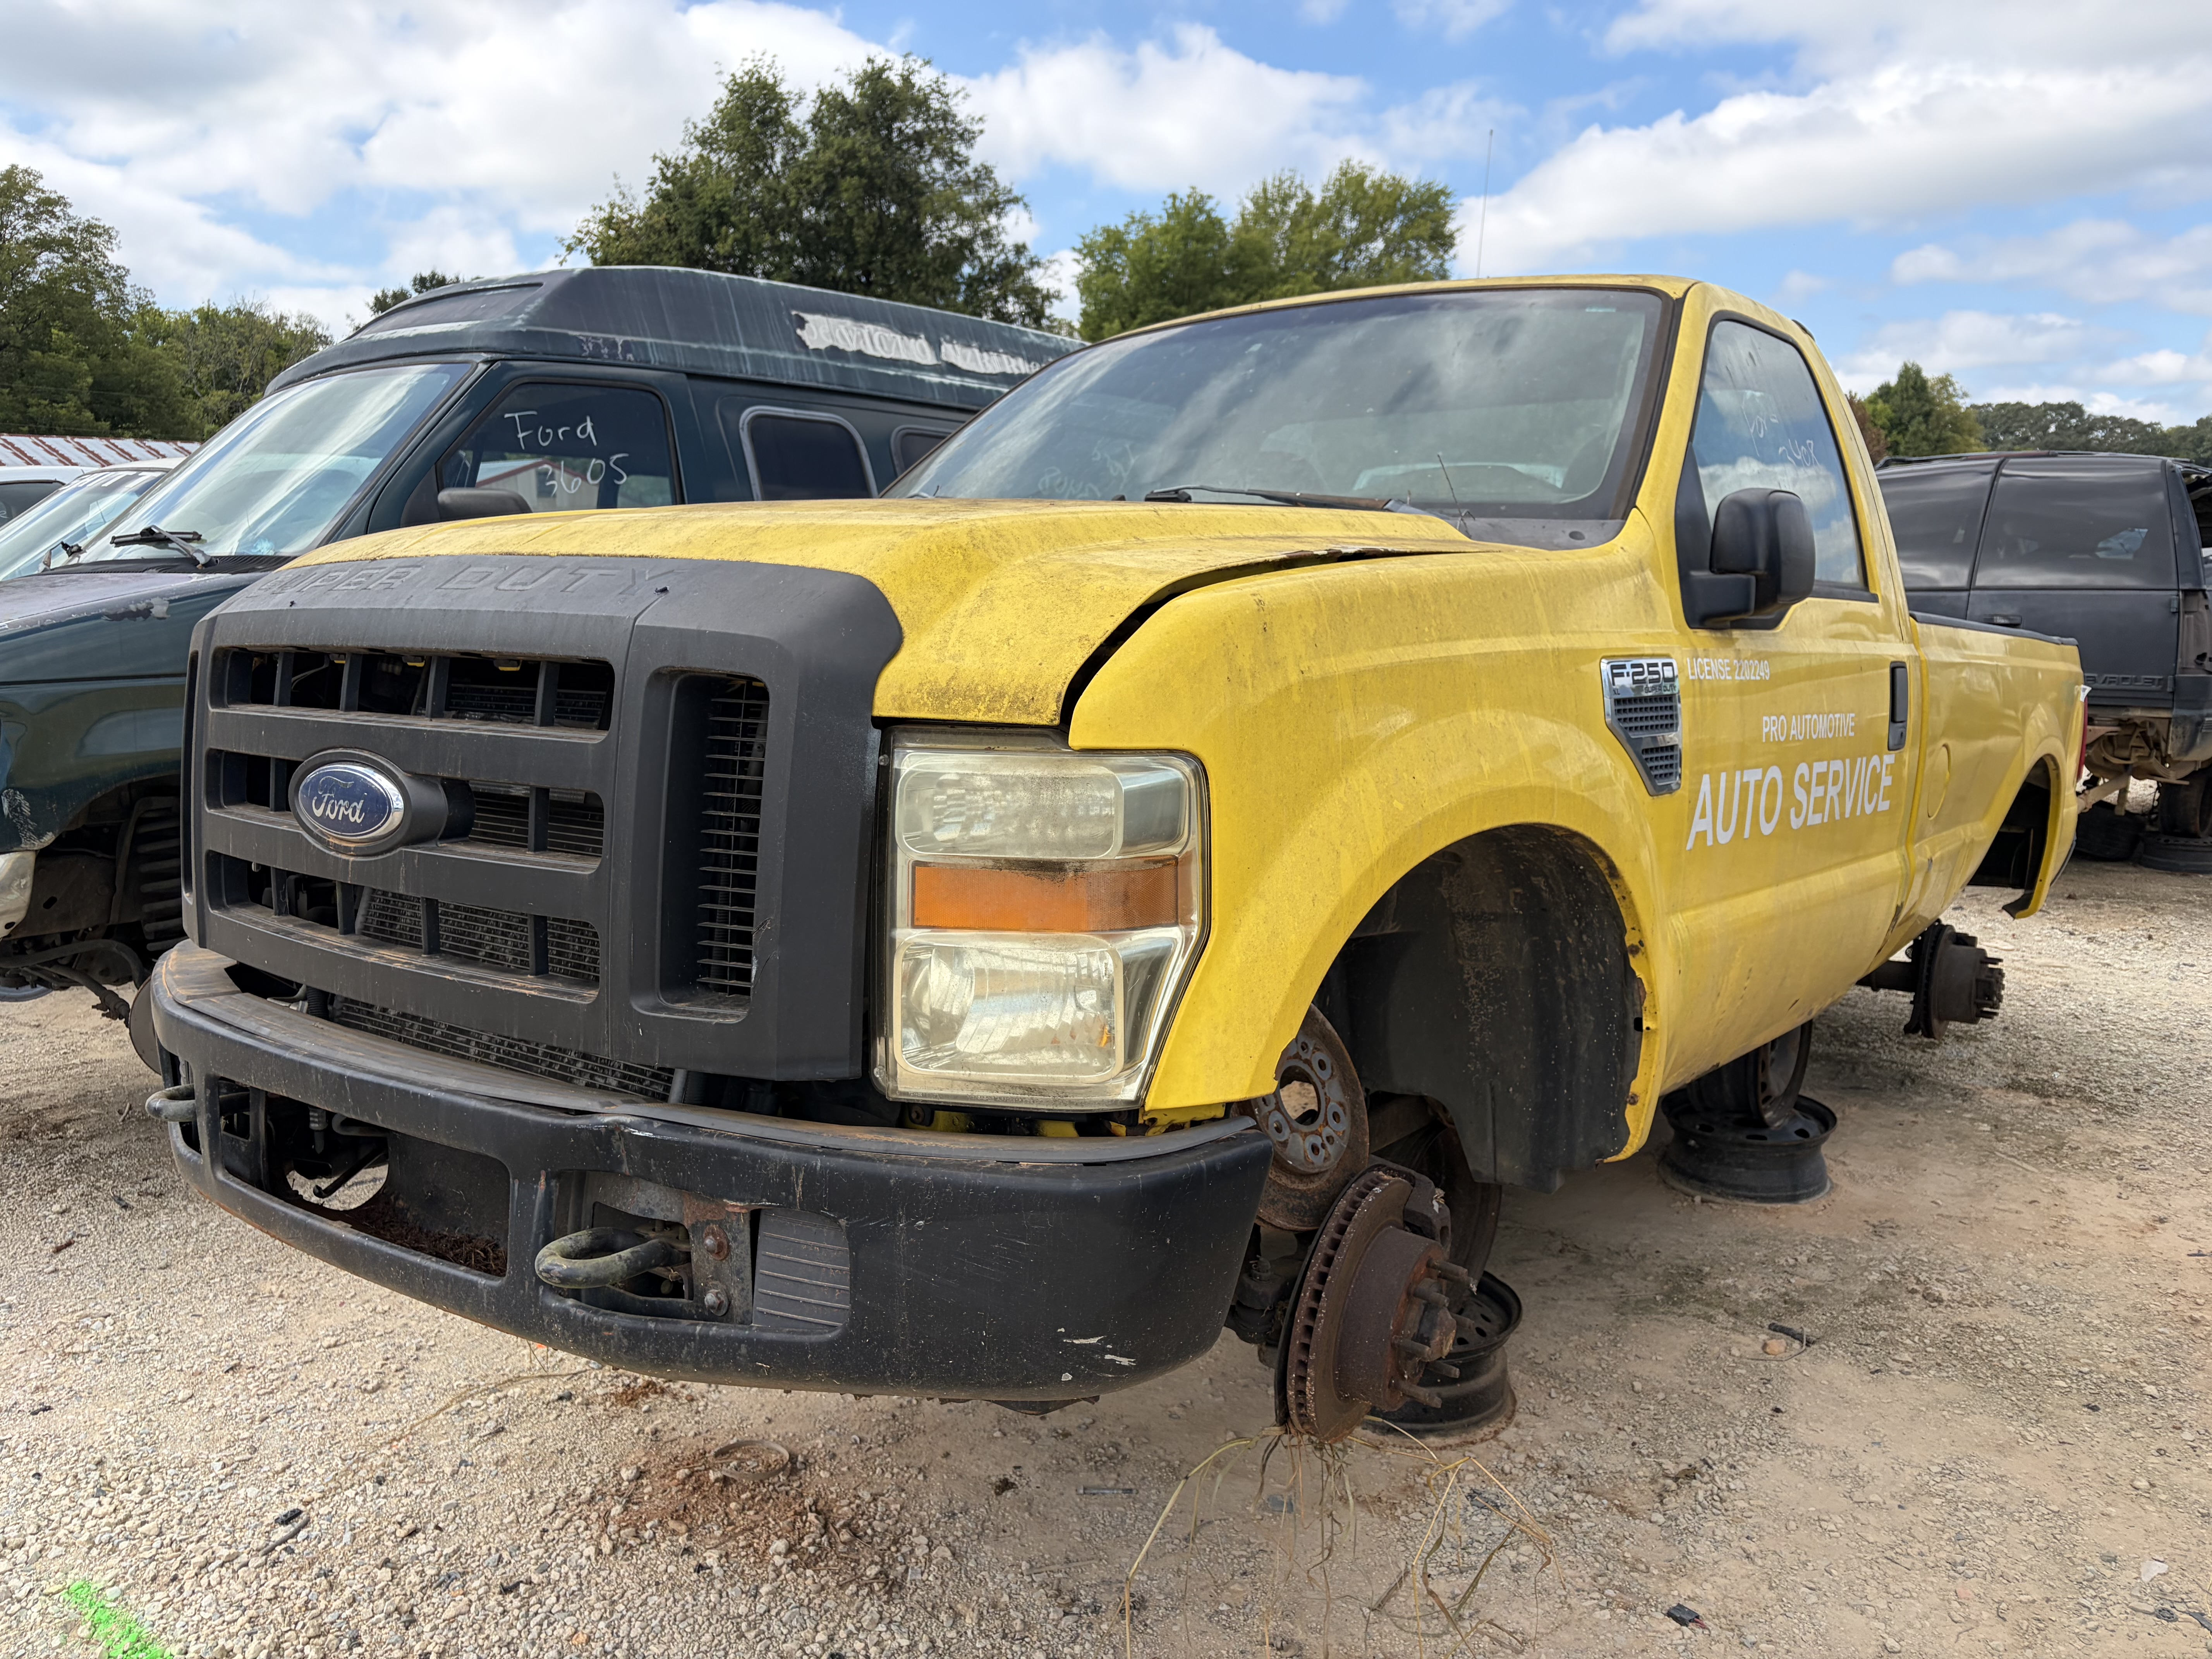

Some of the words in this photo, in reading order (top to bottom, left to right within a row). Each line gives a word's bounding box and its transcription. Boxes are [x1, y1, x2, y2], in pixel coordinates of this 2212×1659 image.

[505, 410, 597, 450] Ford
[247, 565, 426, 598] SUPER
[435, 565, 689, 596] DUTY
[1687, 657, 1732, 680] LICENSE
[1733, 659, 1770, 680] 2202249
[2084, 673, 2163, 689] EVROLET
[1762, 715, 1787, 742] PRO
[1790, 713, 1855, 741] AUTOMOTIVE
[312, 776, 365, 823] Ford
[1686, 765, 1782, 850] AUTO
[1790, 754, 1896, 830] SERVICE
